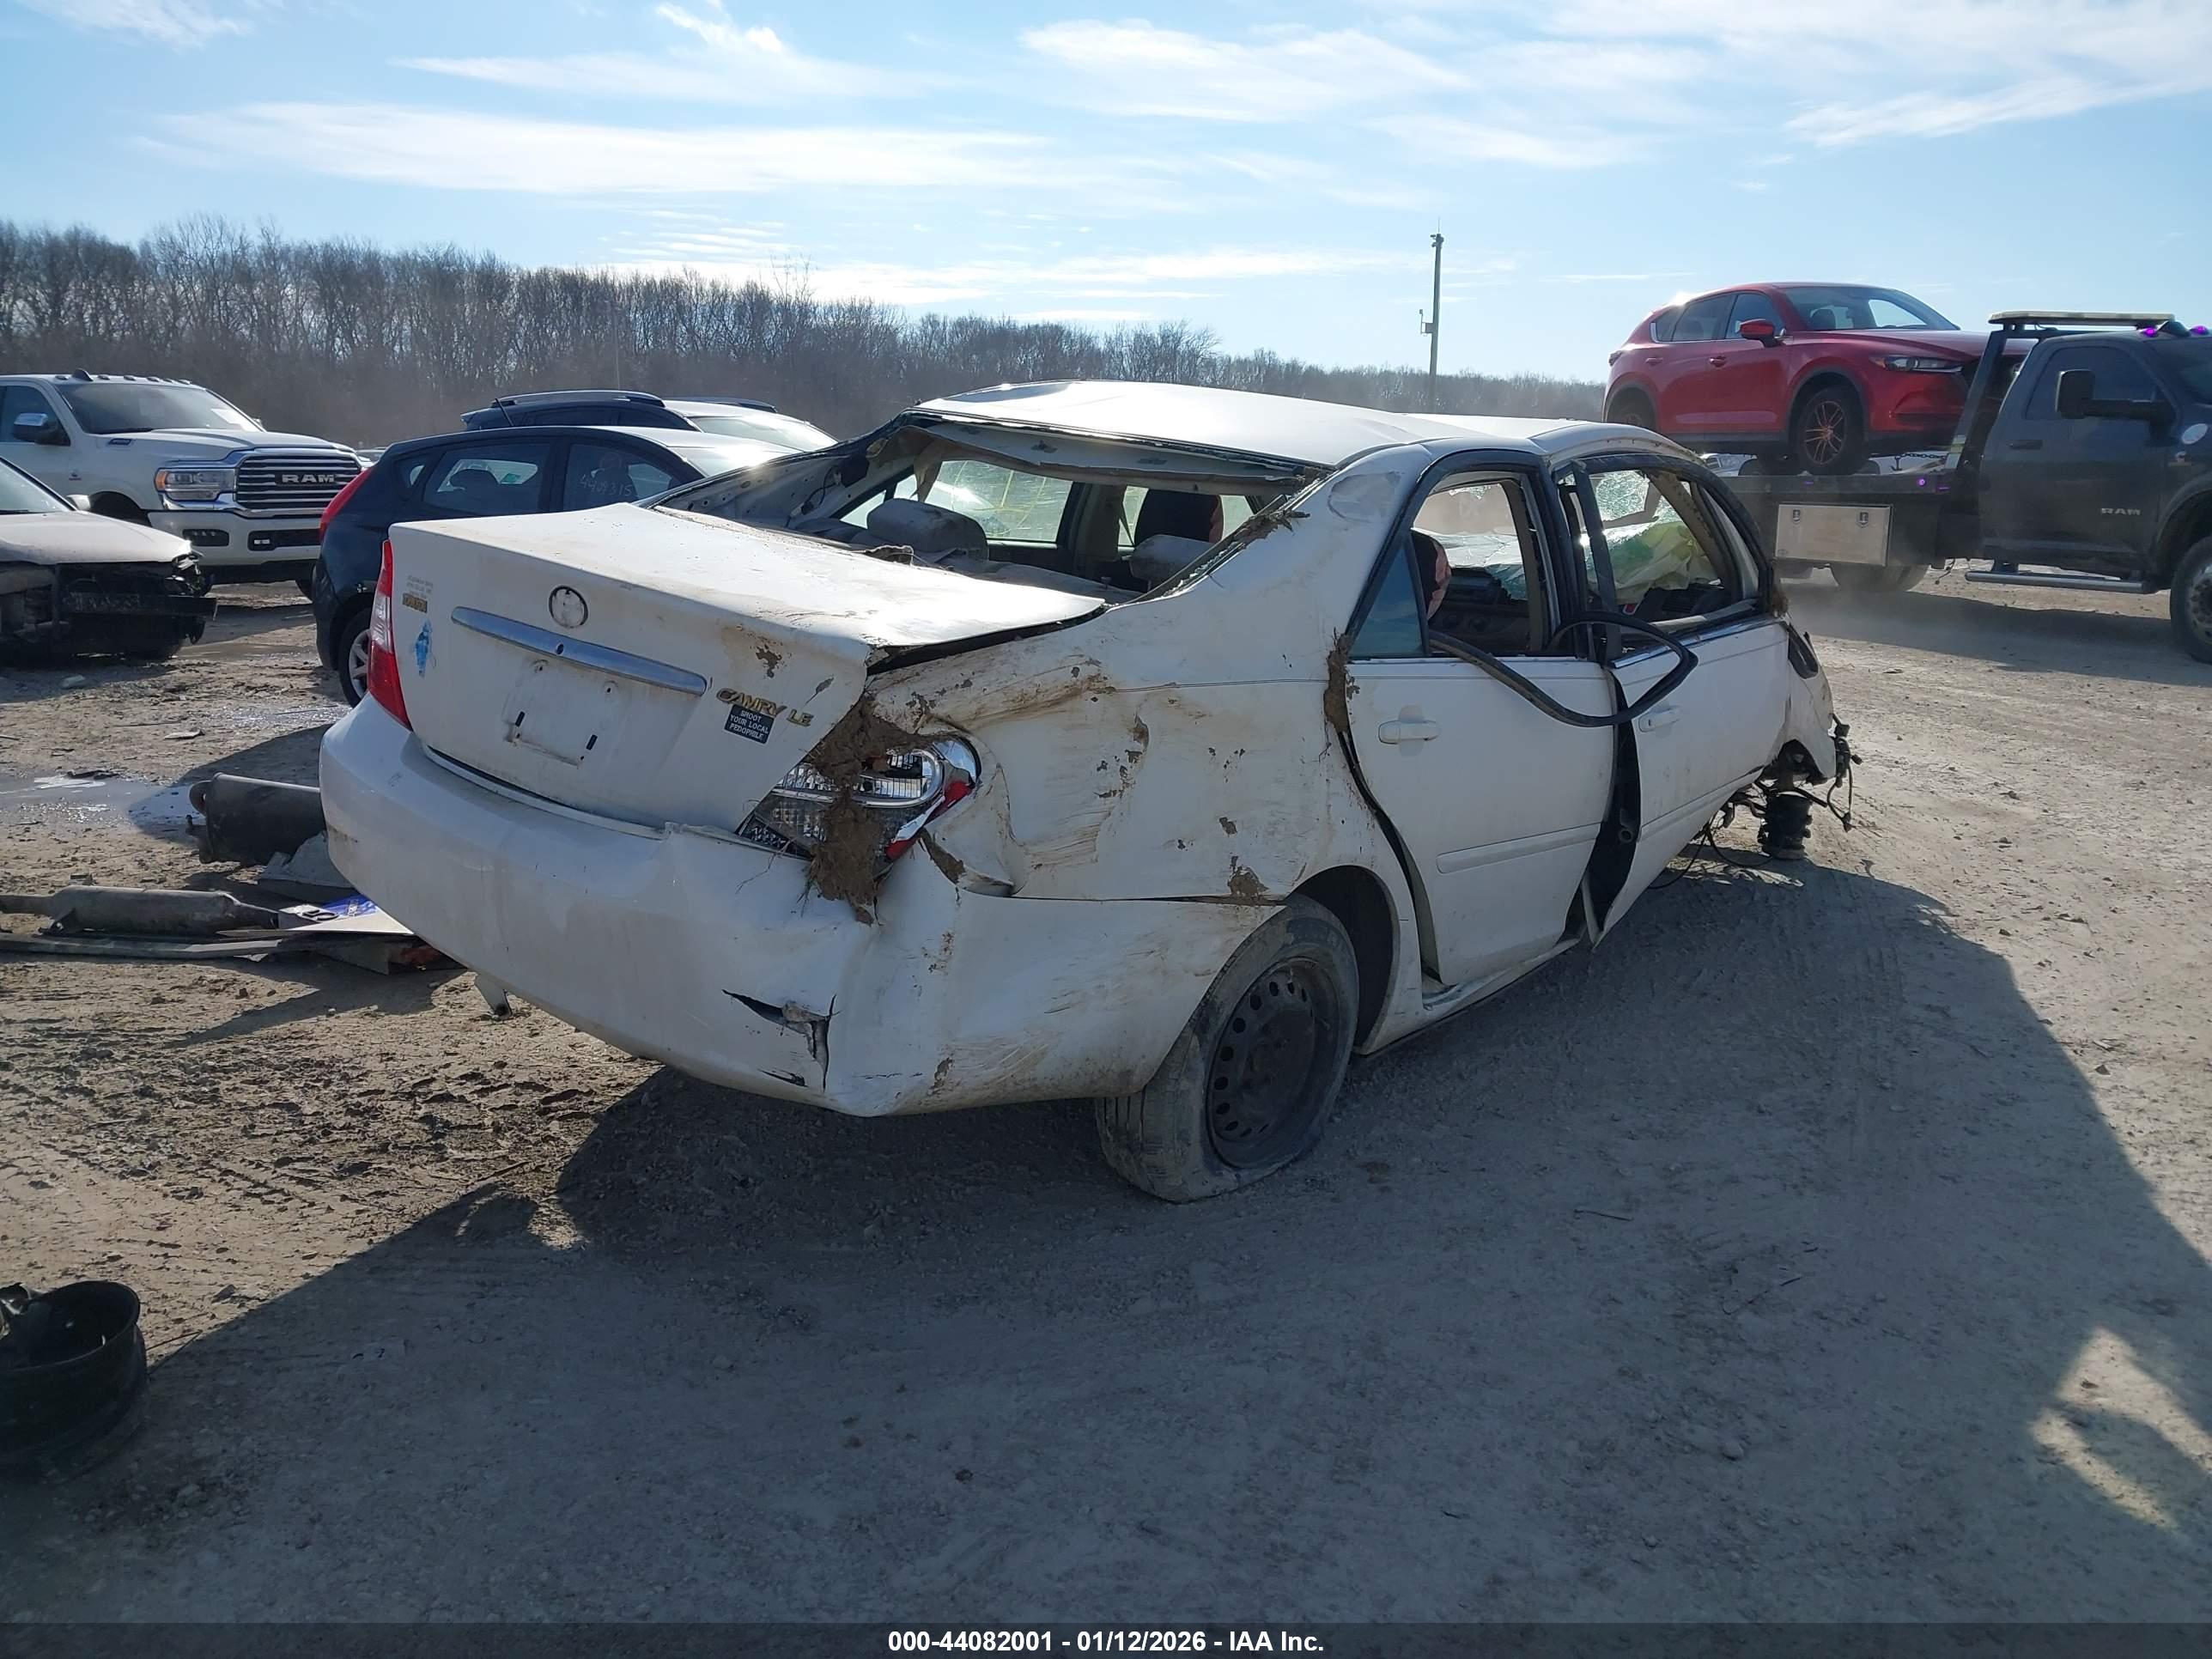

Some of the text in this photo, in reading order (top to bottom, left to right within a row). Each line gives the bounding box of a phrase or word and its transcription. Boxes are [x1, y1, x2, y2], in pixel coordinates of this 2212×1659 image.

[281, 473, 335, 483] RAM
[2100, 507, 2142, 516] RAM
[716, 688, 814, 726] CAMRY LE
[740, 709, 763, 722] SHOOT
[728, 722, 765, 741] PEDOPHILE
[730, 714, 769, 735] YOUR LOCAL
